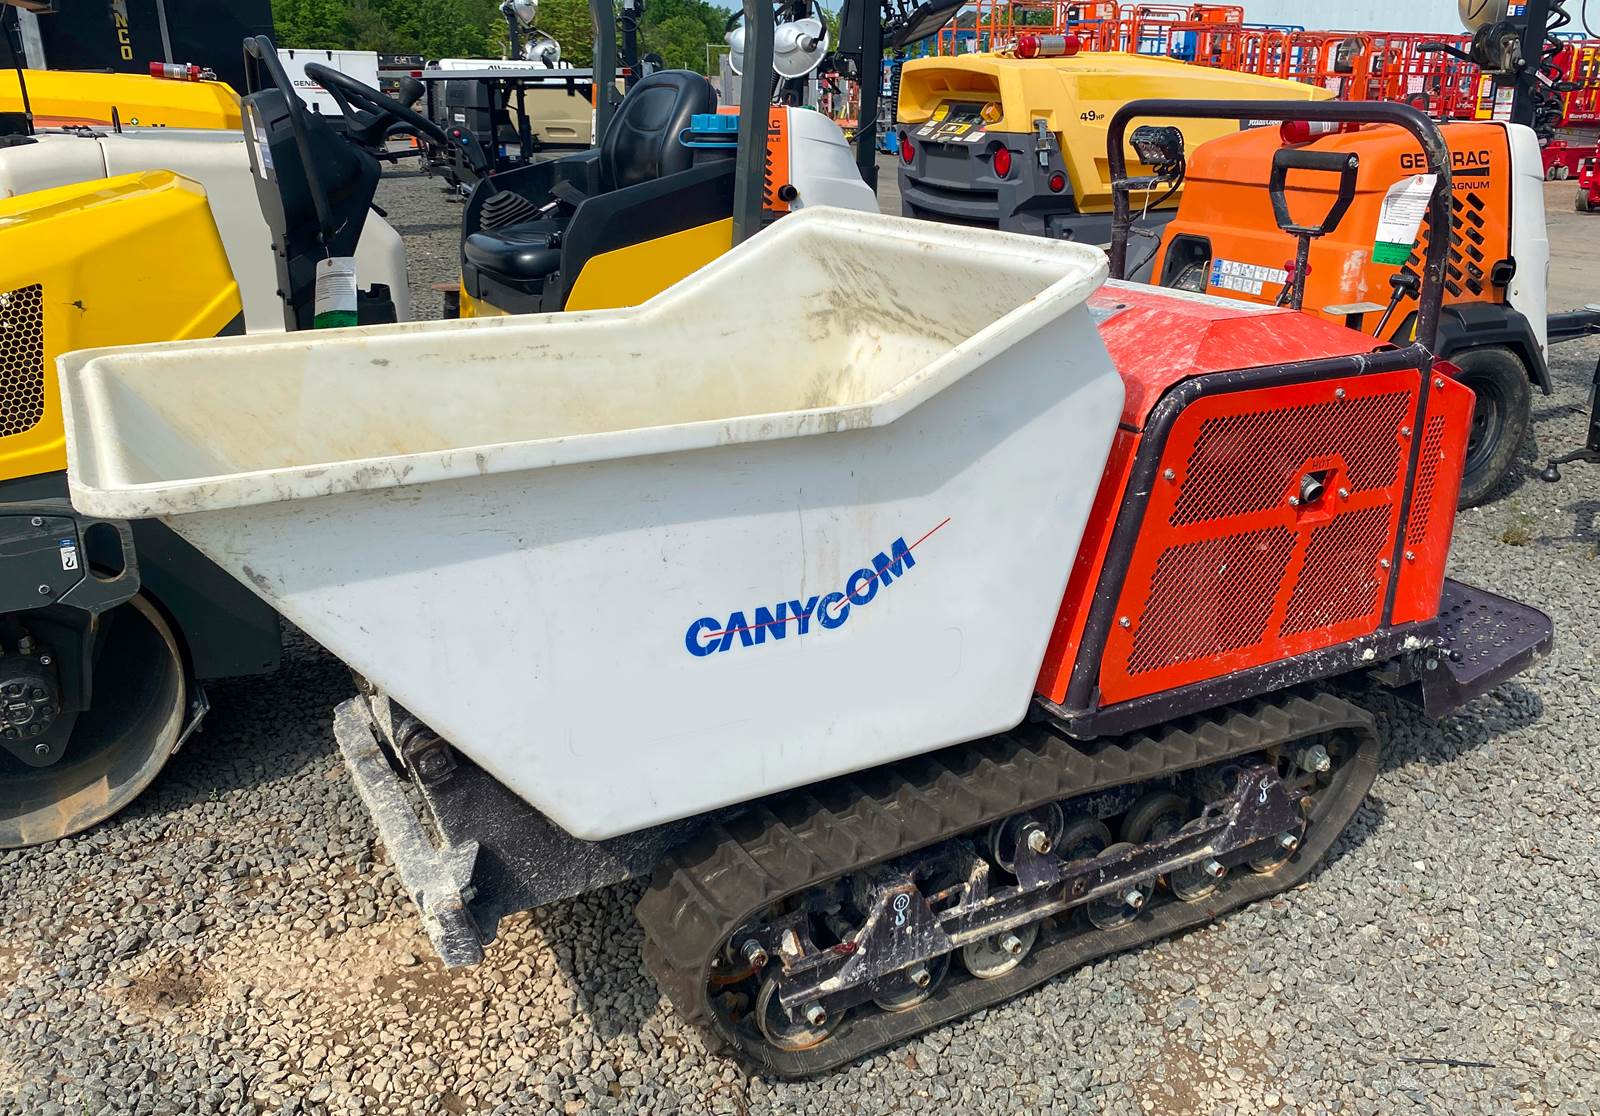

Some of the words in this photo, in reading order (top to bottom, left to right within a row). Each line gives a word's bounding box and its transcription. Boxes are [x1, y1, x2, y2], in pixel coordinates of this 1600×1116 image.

[293, 80, 321, 88] GENE
[1400, 150, 1490, 169] GERAC
[1451, 181, 1490, 191] AGNUM
[685, 536, 916, 657] CANYCOM
